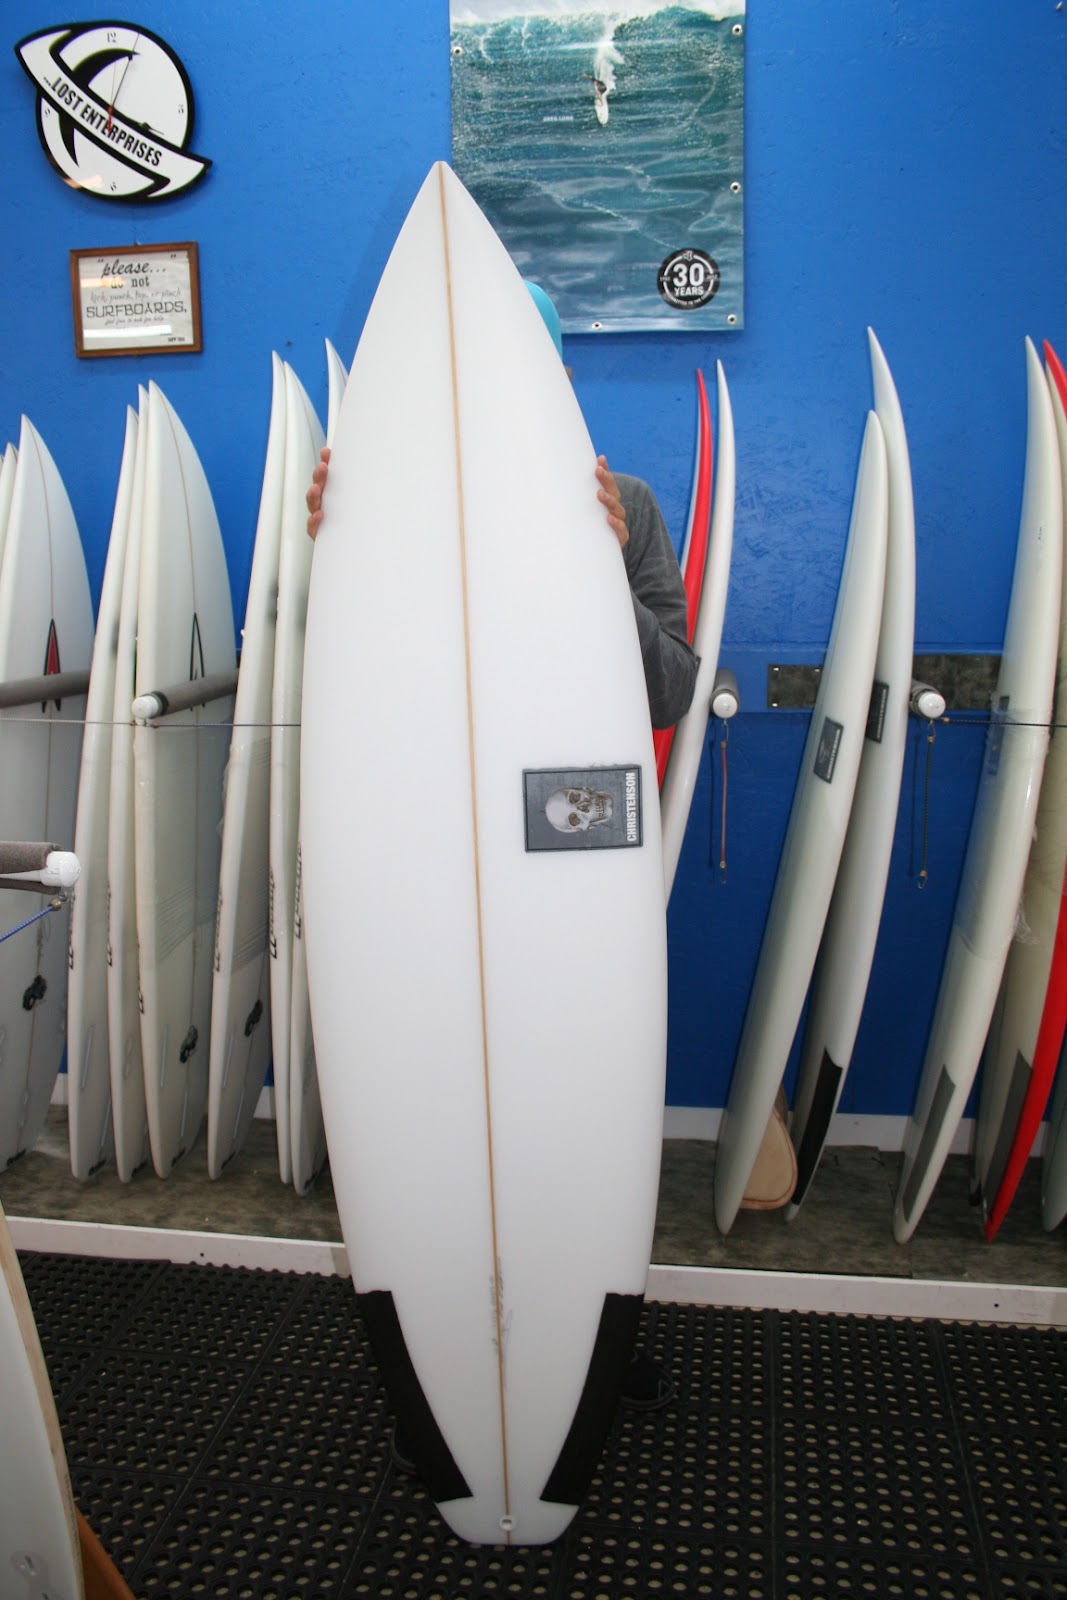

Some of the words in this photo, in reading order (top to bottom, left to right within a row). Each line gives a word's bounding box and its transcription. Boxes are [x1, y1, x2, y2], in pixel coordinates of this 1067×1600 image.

[80, 104, 162, 167] ENTERPRISES
[131, 276, 150, 288] not
[673, 263, 704, 287] 30
[673, 286, 704, 297] YEARS
[625, 772, 636, 842] CHRISTENSON
